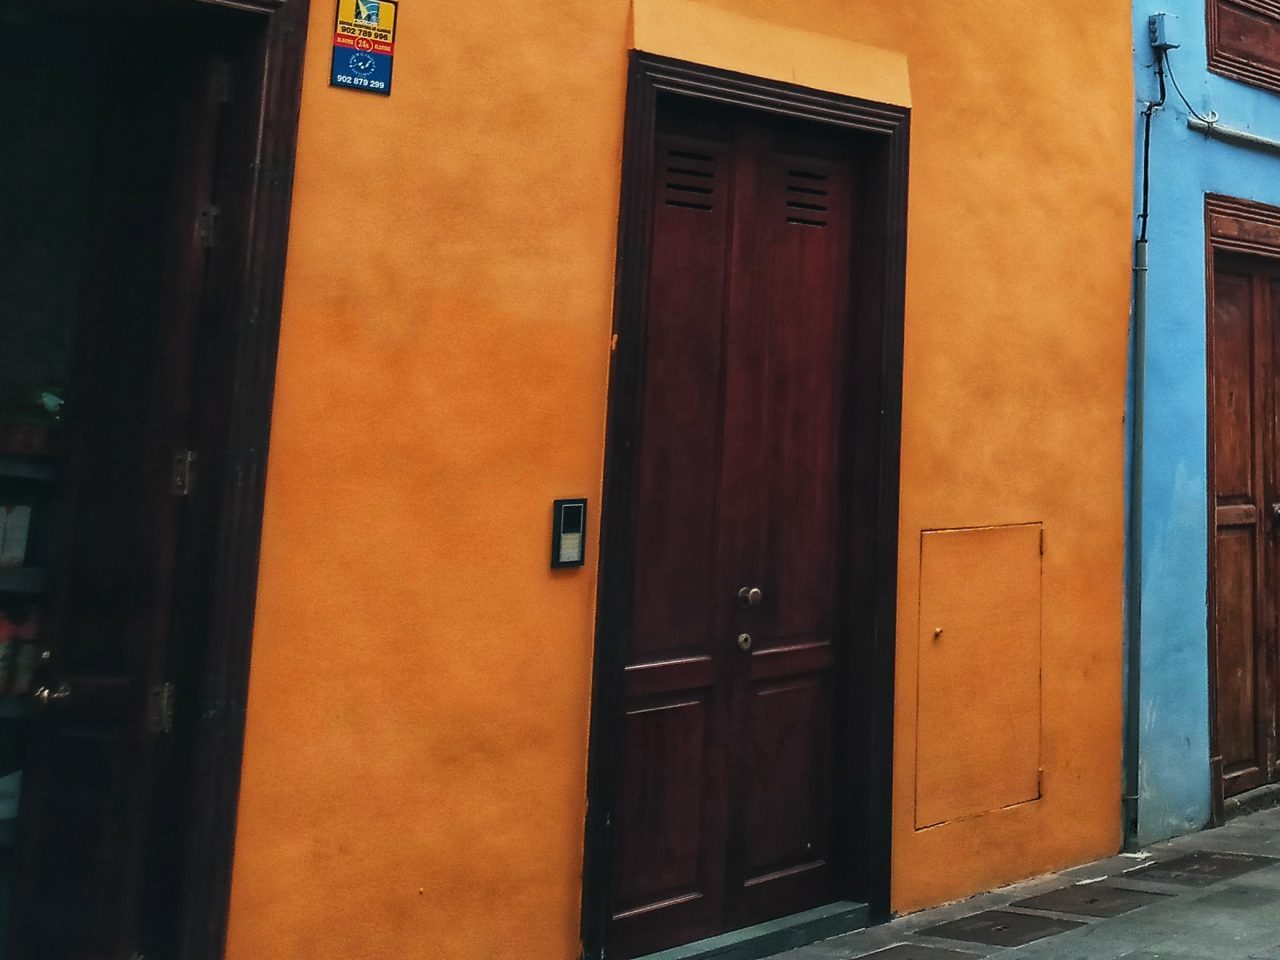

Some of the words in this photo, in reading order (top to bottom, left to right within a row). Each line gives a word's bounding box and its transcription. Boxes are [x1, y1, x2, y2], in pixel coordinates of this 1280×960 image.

[341, 26, 356, 35] 902
[337, 75, 352, 84] 902
[353, 77, 369, 87] 879
[370, 80, 385, 89] 299
